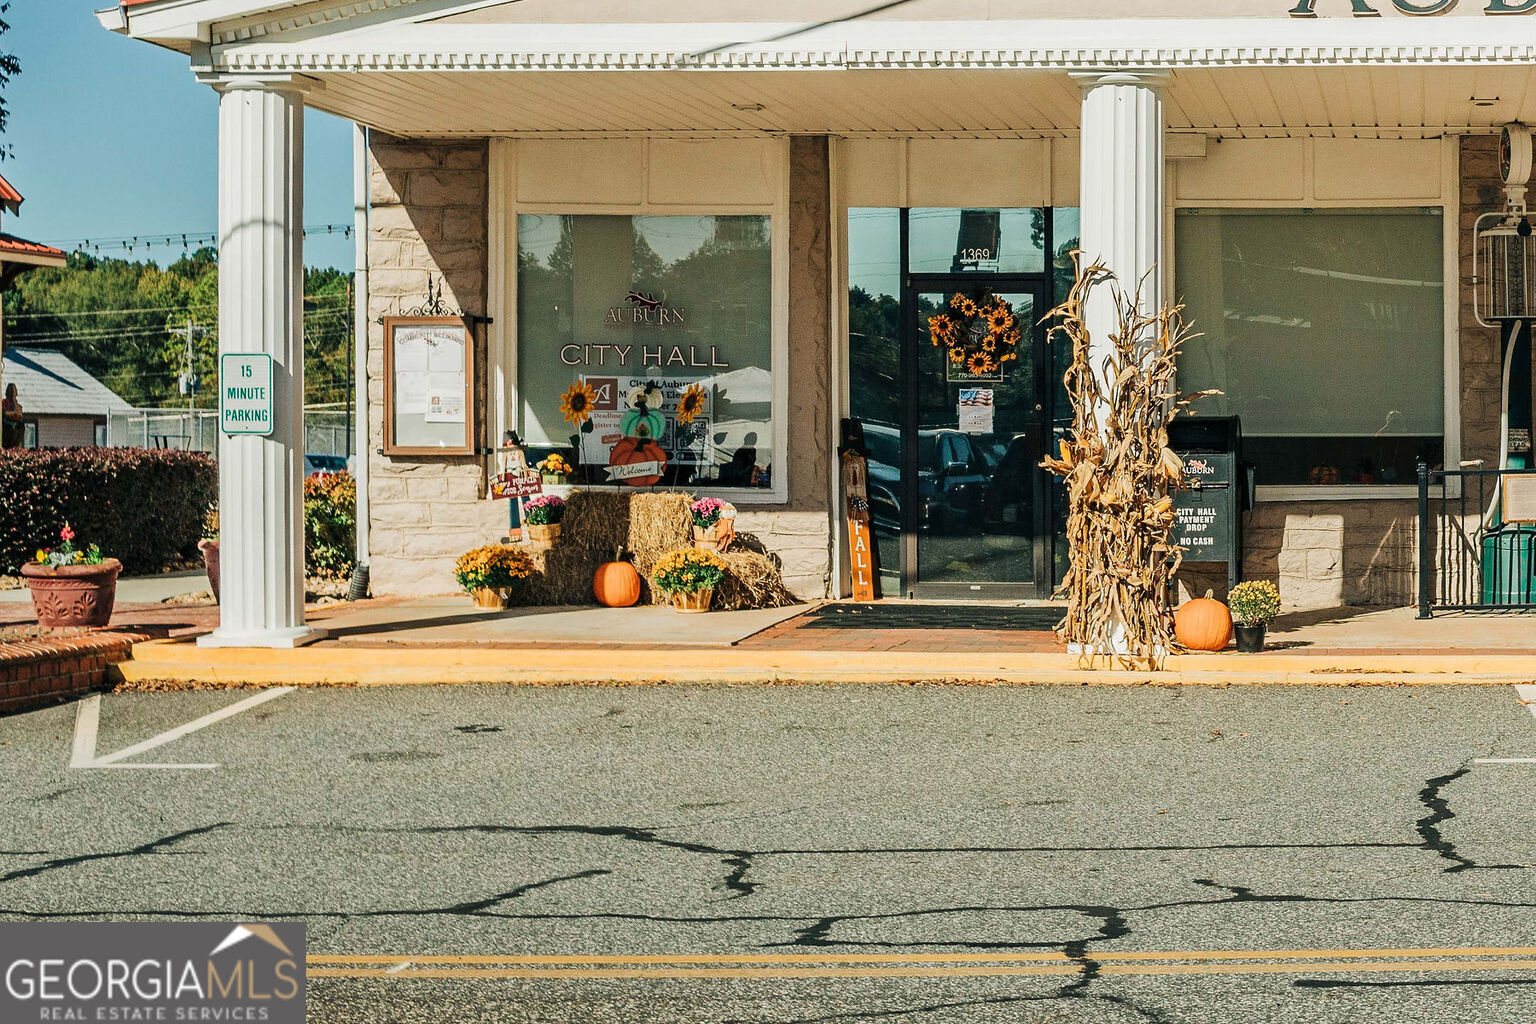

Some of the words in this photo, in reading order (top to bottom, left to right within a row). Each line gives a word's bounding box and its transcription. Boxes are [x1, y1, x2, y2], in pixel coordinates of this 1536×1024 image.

[961, 248, 990, 261] 1369
[604, 307, 685, 324] AUBURN
[559, 343, 633, 366] CITY
[642, 345, 729, 368] HALL
[241, 365, 252, 378] 15
[227, 387, 266, 400] MINUTE
[225, 409, 268, 422] PARKING
[1182, 466, 1215, 474] AUBURN
[1176, 508, 1194, 516] CITY
[1197, 508, 1217, 516] HALL
[855, 520, 867, 585] FALL
